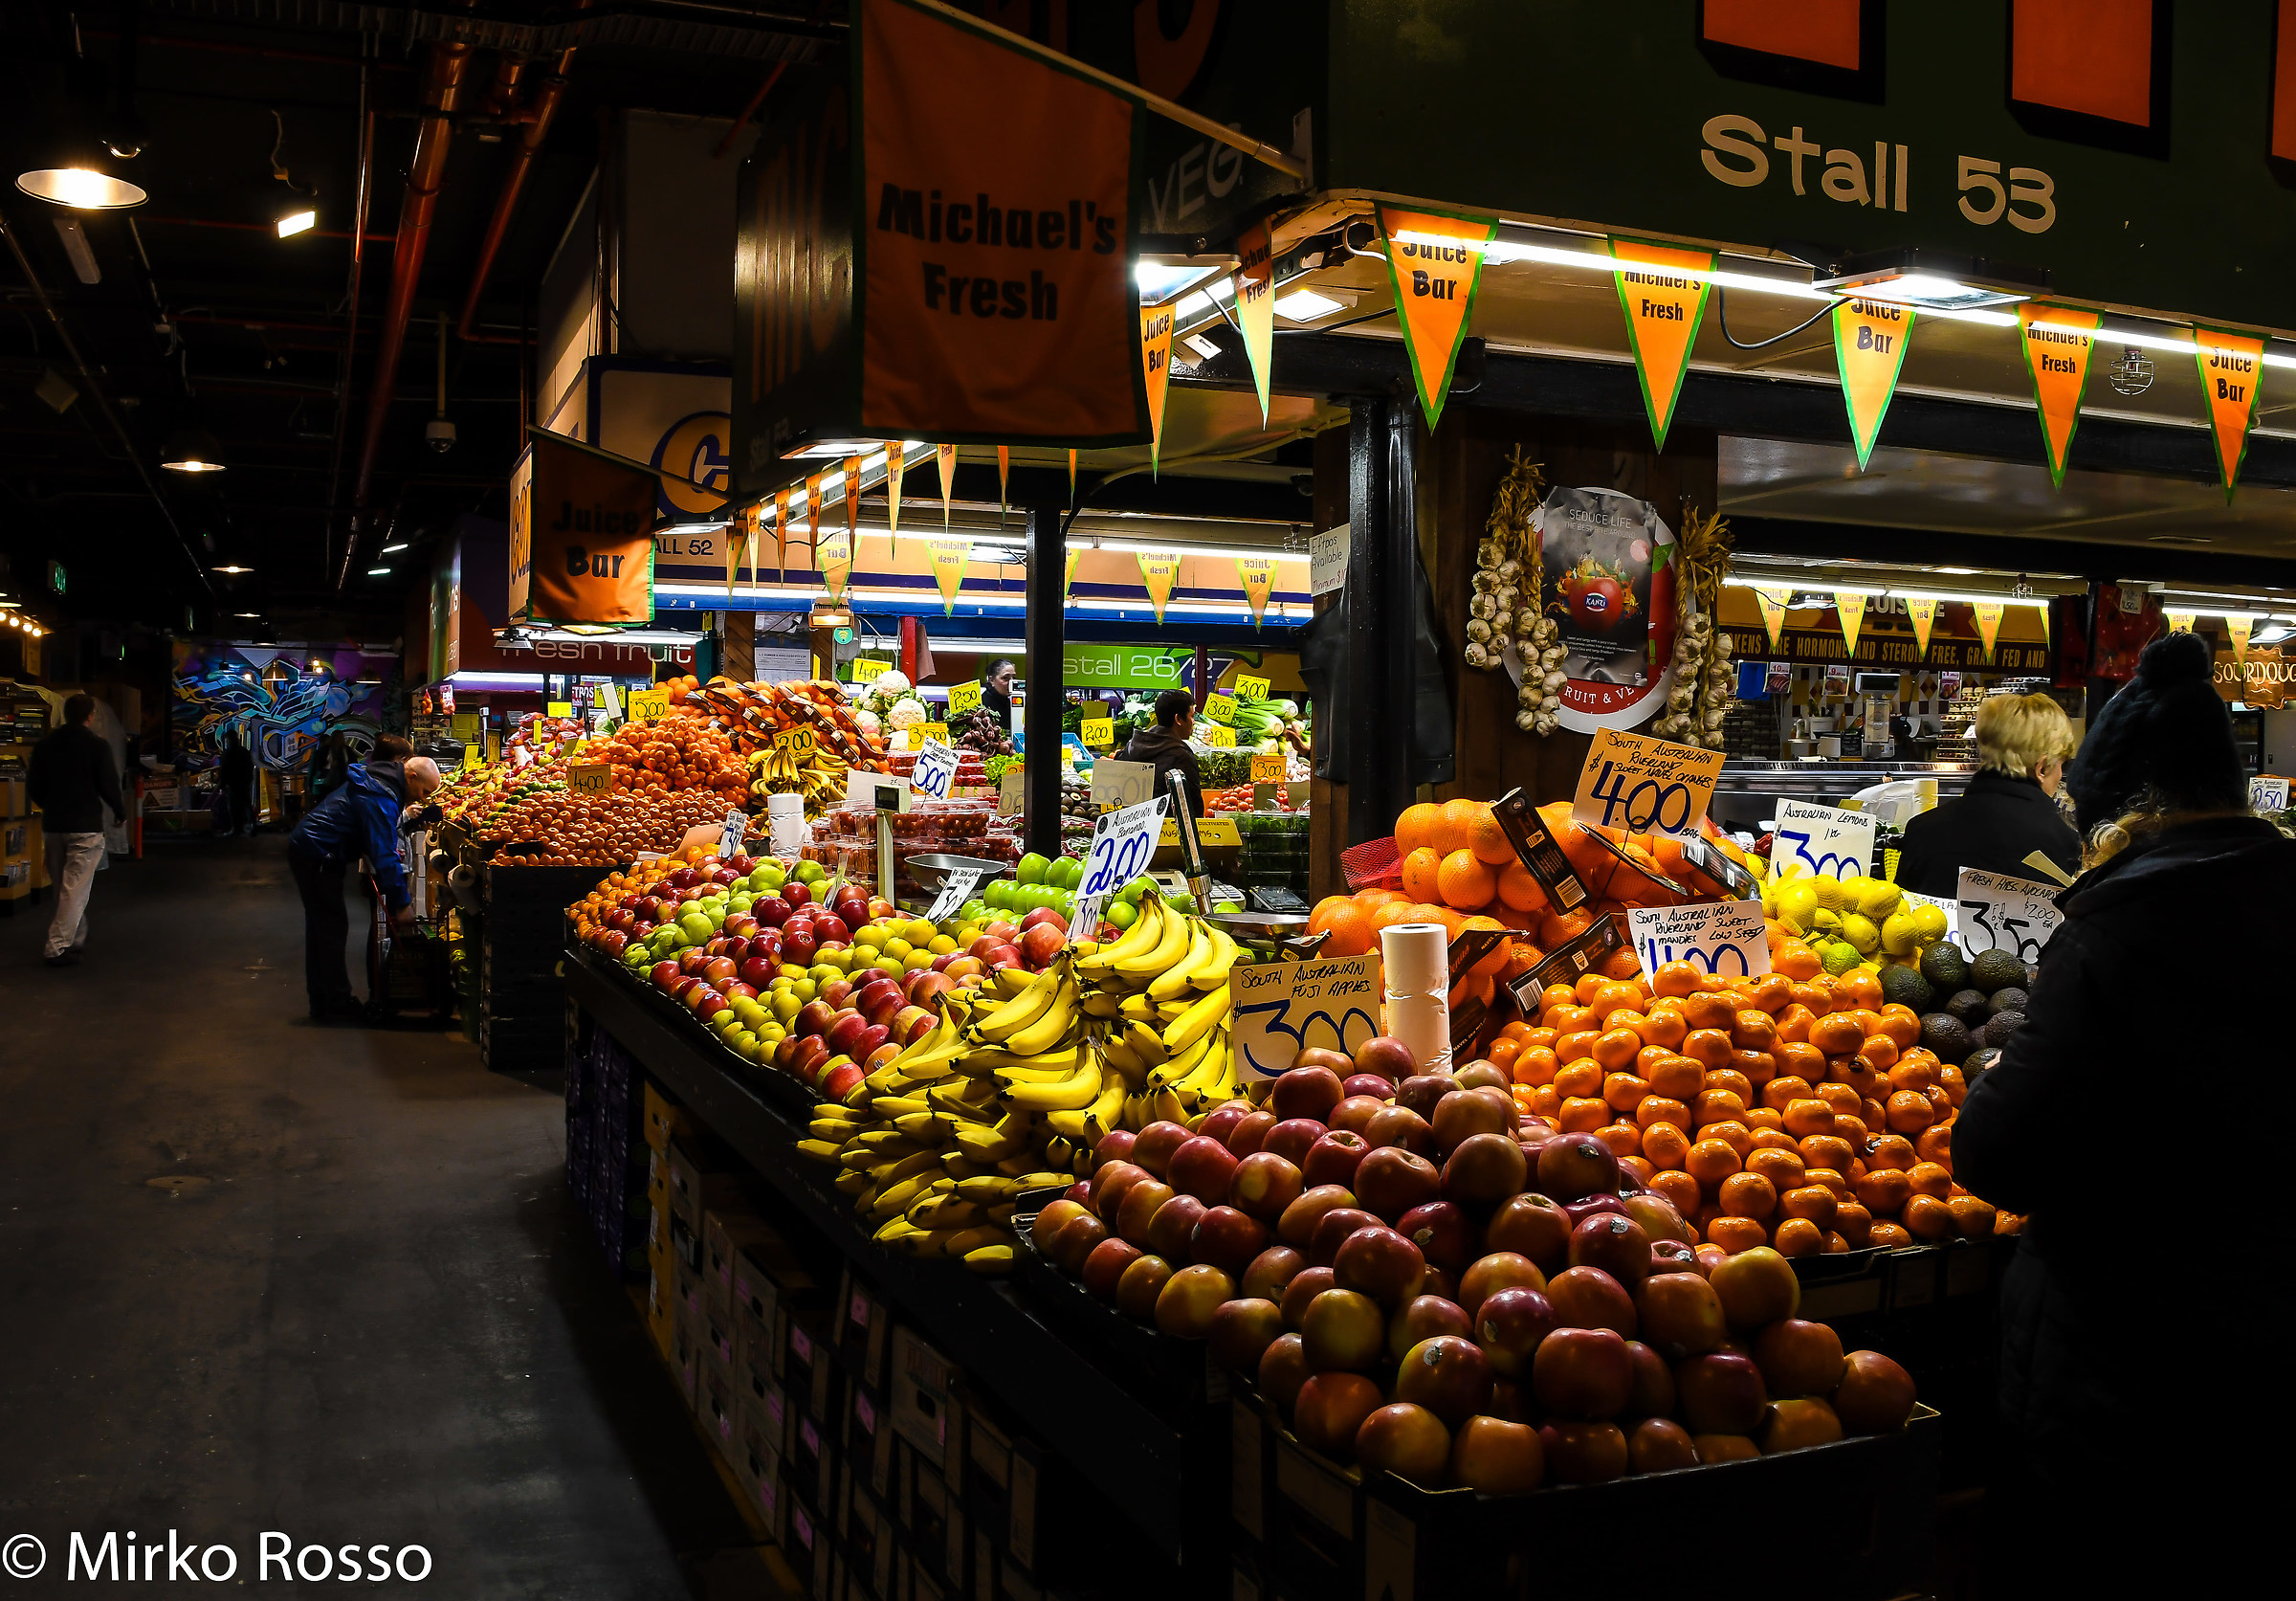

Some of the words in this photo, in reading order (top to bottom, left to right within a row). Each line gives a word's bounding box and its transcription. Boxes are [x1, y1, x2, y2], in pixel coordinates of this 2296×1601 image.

[1700, 114, 1909, 212] Stall
[1957, 154, 2057, 234] 53
[876, 182, 1117, 257] Michael's
[922, 261, 1059, 322] Fresh
[1412, 269, 1459, 301] Bar
[1641, 298, 1685, 322] Fresh
[1143, 313, 1170, 343] Juice
[1857, 325, 1894, 355] Bar
[1148, 347, 1166, 373] Bar
[2041, 353, 2077, 375] Fresh
[2209, 345, 2253, 373] Juice
[2216, 378, 2246, 403] Bar
[552, 501, 639, 534] Juice
[1569, 508, 1608, 525] SEDUCE
[1610, 516, 1632, 529] LIFE
[687, 539, 714, 556] 52
[566, 546, 625, 579] Bar
[1585, 596, 1607, 608] KANZI
[1865, 594, 1946, 617] CUISE
[502, 640, 603, 660] esh
[1796, 637, 1848, 659] HORMONE
[1854, 640, 1876, 661] AND
[2001, 649, 2020, 668] FED
[2025, 650, 2045, 669] AND
[1063, 654, 1121, 676] stall
[1564, 685, 1597, 704] RUIT
[1602, 693, 1612, 704] &
[1607, 731, 1644, 750] SOUTH
[1649, 741, 1714, 765] AUSTRALIAN
[1836, 811, 1869, 827] LEMONS
[1965, 872, 1995, 886] FRESH
[1635, 910, 1661, 924] SOUTH
[1667, 904, 1734, 923] AUSTRALIAN
[1709, 930, 1733, 941] LOW
[1241, 967, 1283, 989] SOUTH
[1292, 961, 1365, 984] AUSTRALIAN
